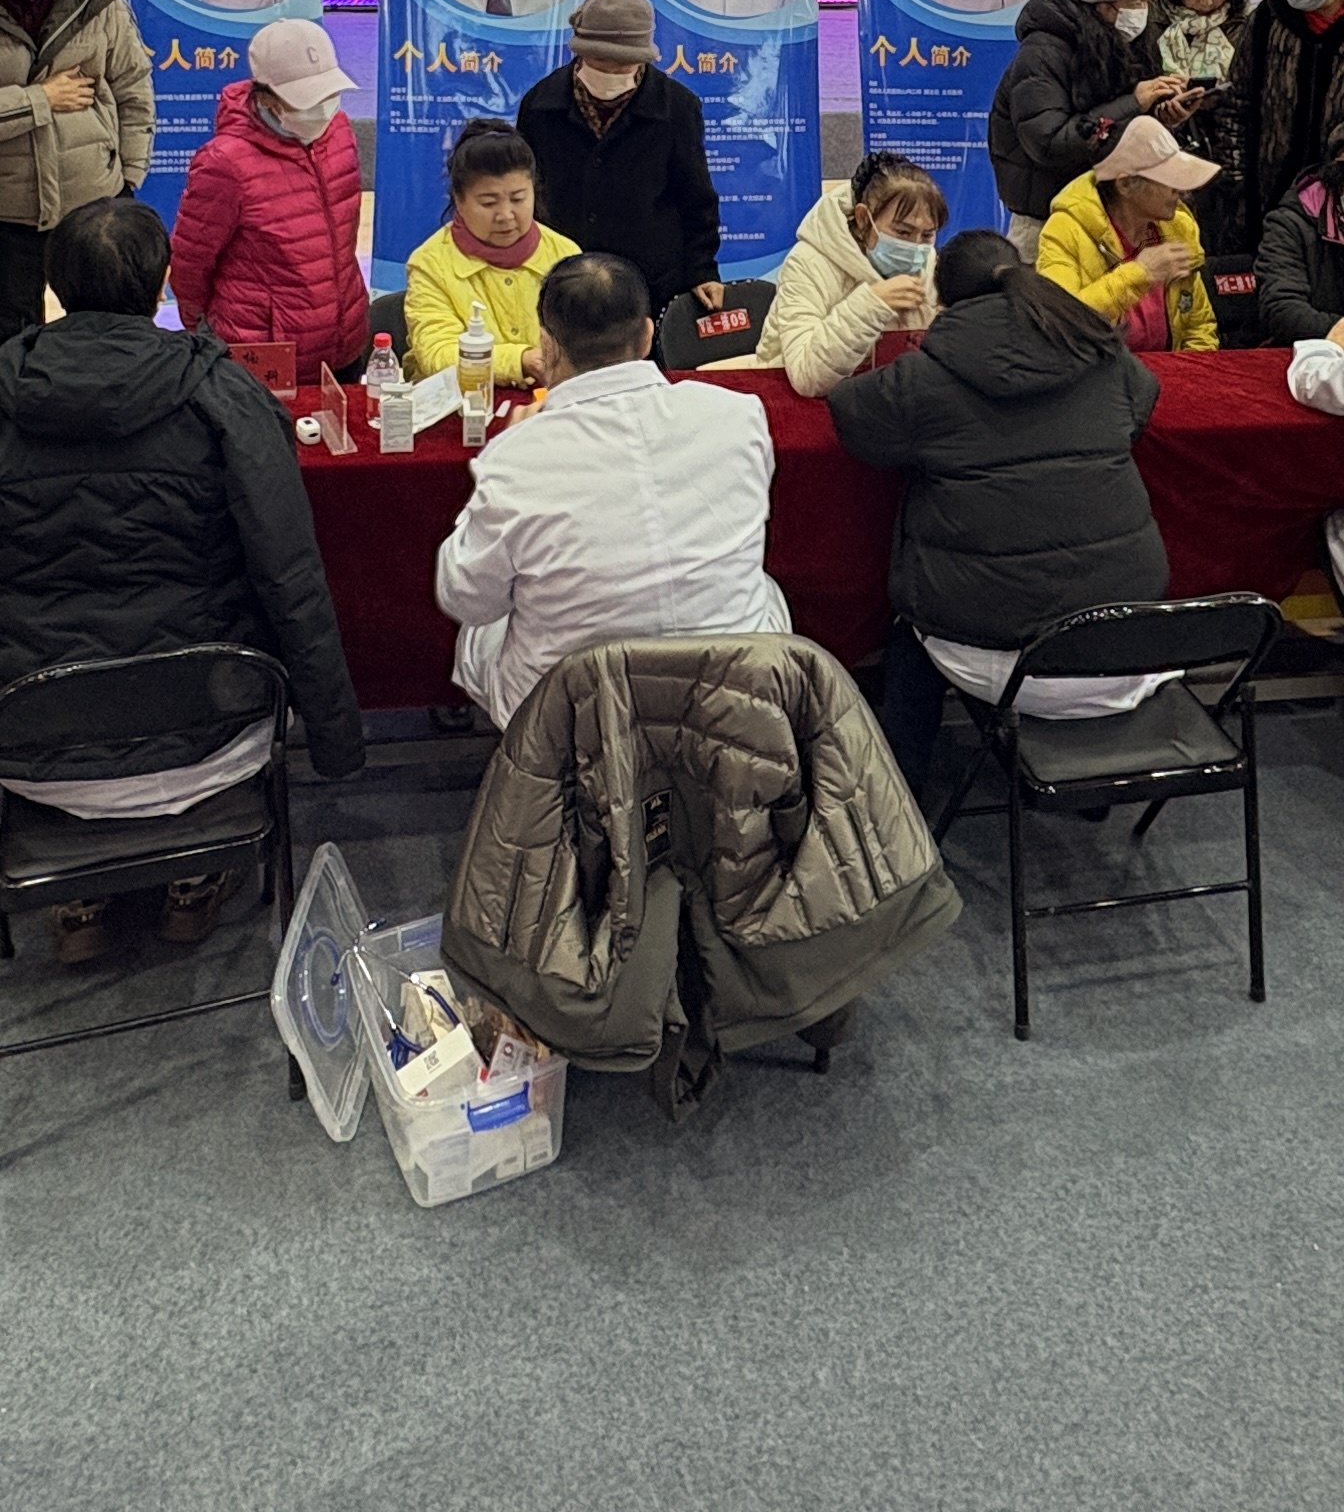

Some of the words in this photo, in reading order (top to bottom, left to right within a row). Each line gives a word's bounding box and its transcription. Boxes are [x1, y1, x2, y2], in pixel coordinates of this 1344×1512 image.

[146, 38, 240, 71] 人简介
[393, 41, 503, 74] 个人简介
[655, 44, 739, 76] 人简介
[869, 34, 972, 69] 个人简介
